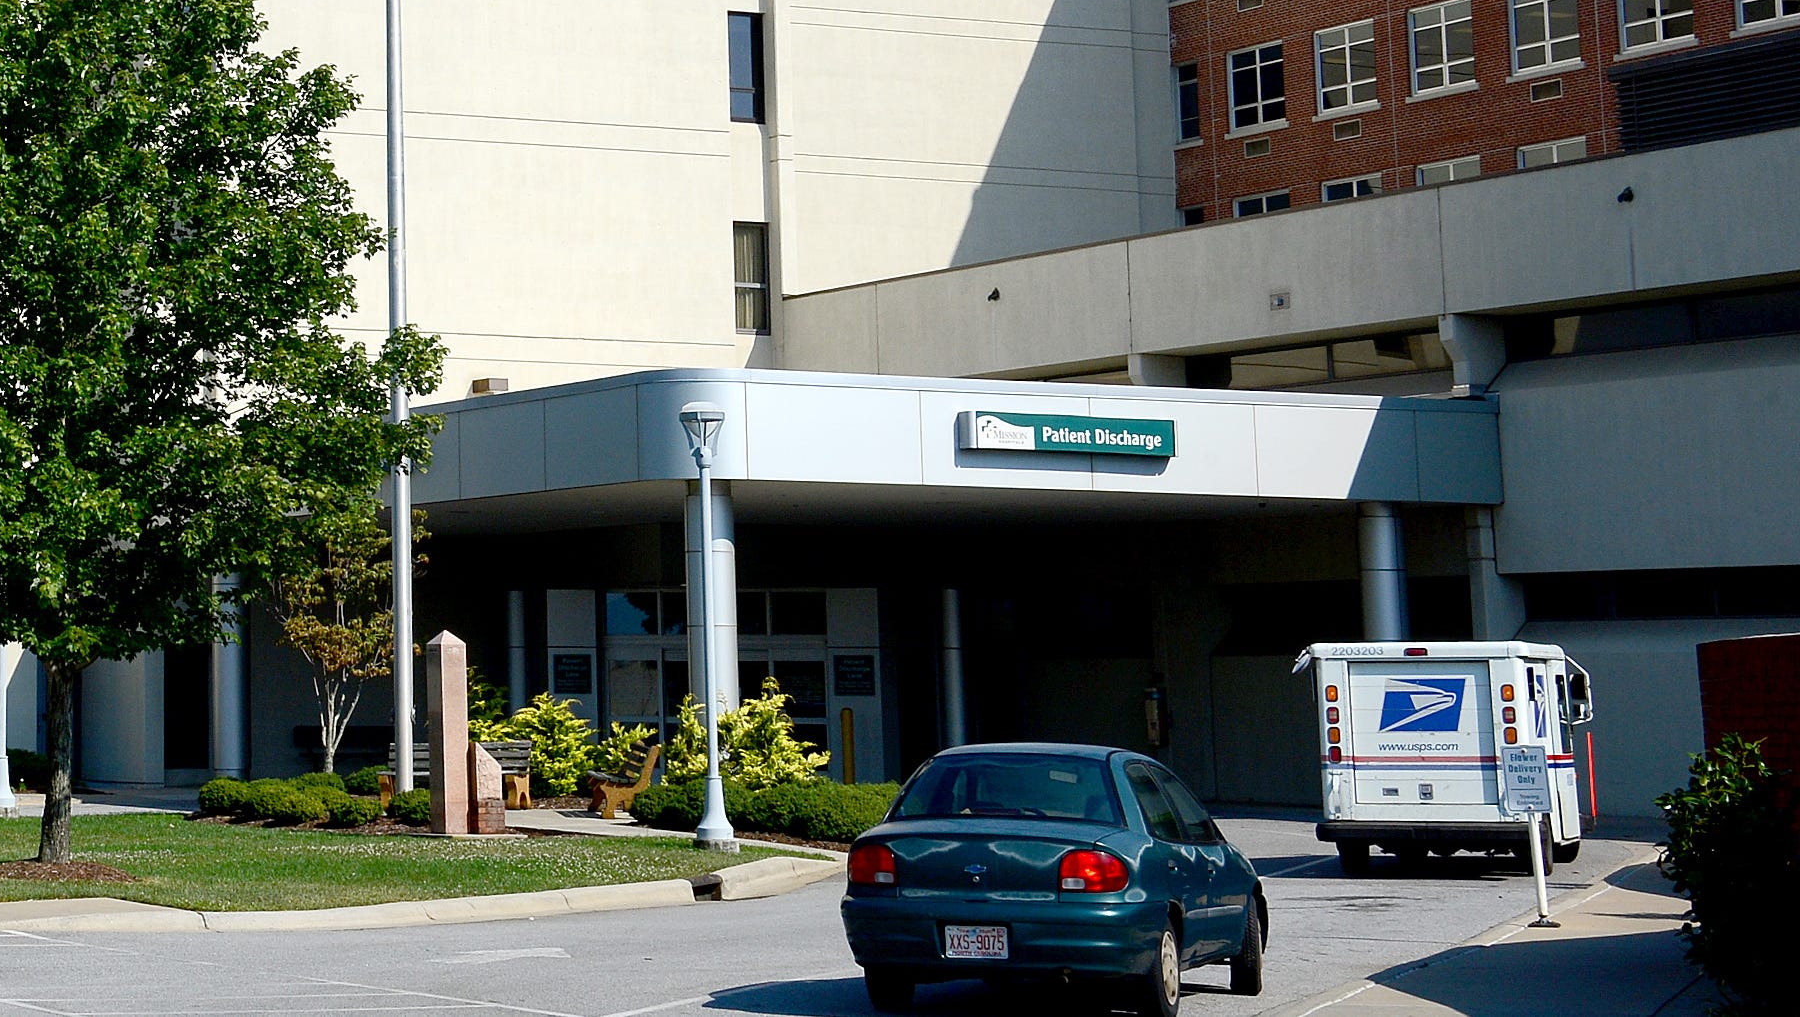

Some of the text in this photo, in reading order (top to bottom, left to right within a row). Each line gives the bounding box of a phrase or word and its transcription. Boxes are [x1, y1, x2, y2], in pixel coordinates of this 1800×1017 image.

[1041, 426, 1162, 450] Patient Discharge
[1331, 646, 1384, 656] 2203203
[1378, 743, 1459, 753] www.usps.com
[1510, 754, 1538, 762] Flower
[1508, 765, 1542, 774] Delivery
[1517, 775, 1536, 785] Only
[949, 934, 1005, 951] XXS-9075
